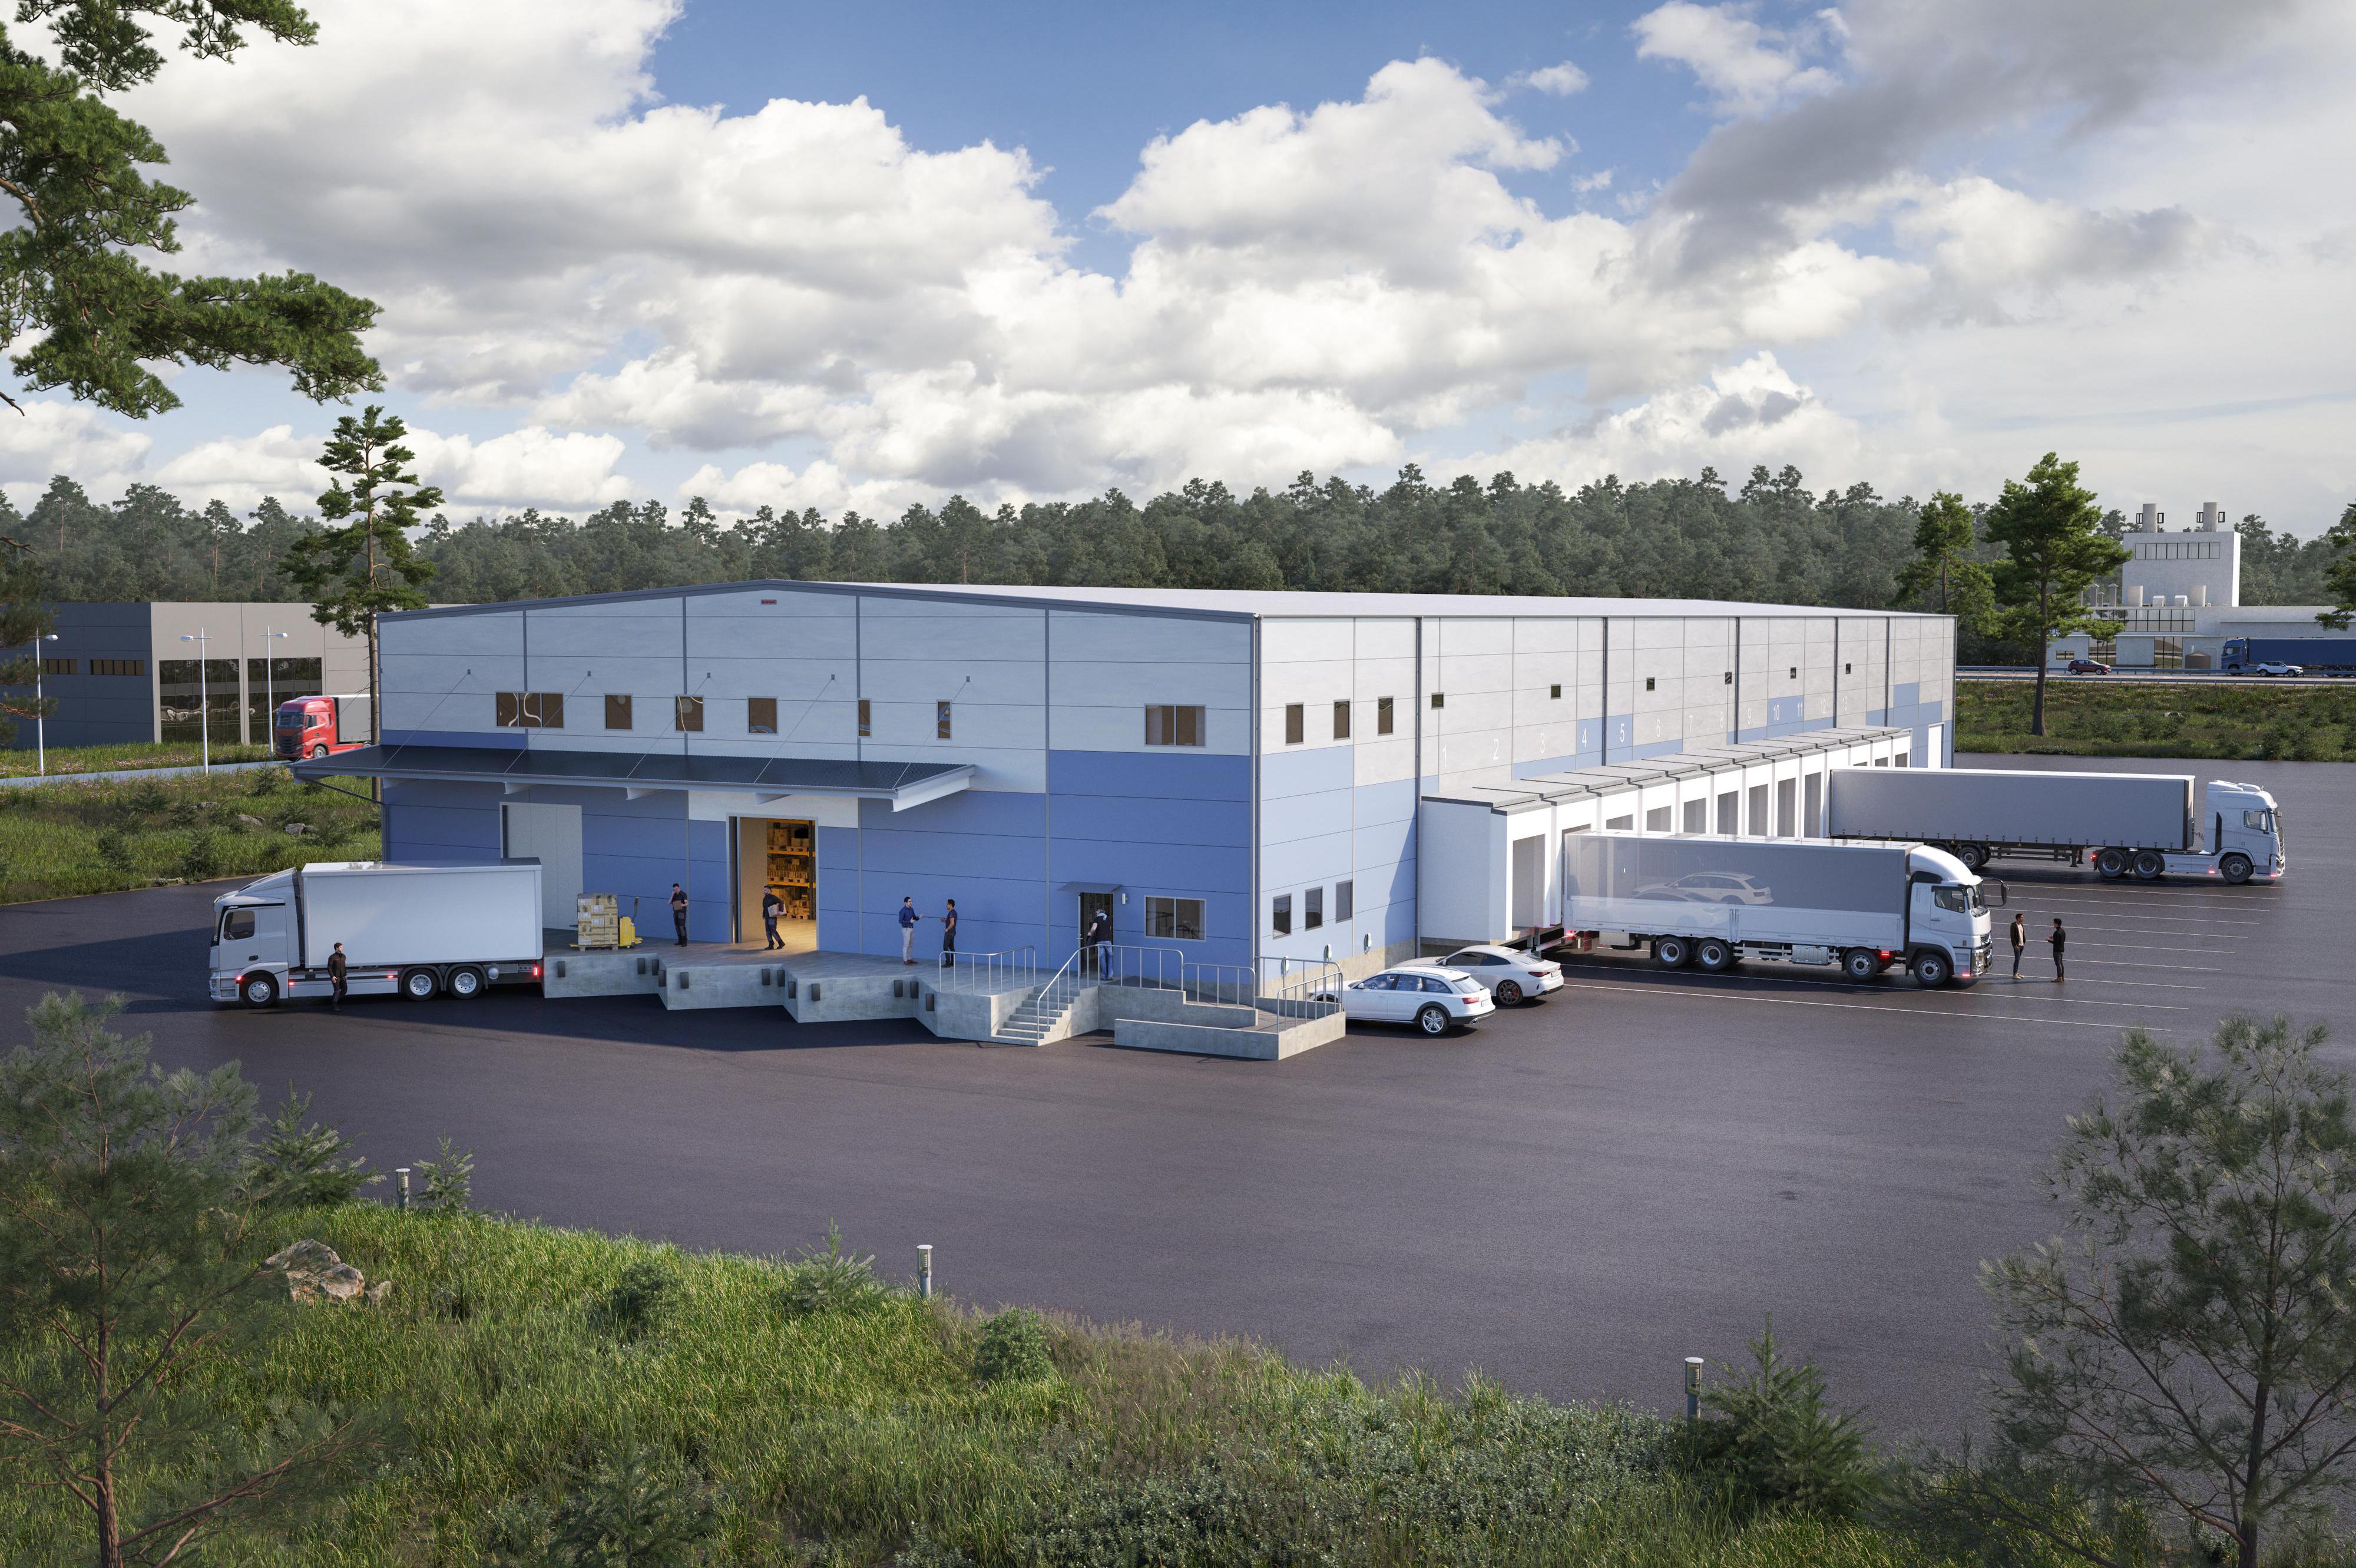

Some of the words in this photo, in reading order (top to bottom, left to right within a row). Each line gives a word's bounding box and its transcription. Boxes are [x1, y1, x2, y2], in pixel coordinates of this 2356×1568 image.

[1773, 704, 1780, 720] 10
[1797, 702, 1803, 717] 11
[1821, 699, 1826, 714] 12
[1842, 696, 1848, 711] 13
[1689, 715, 1693, 732] 7
[1720, 712, 1724, 729] 8
[1748, 708, 1752, 725] 9
[1620, 723, 1625, 742] 5
[1656, 719, 1661, 737] 6
[1540, 733, 1545, 754] 3
[1581, 727, 1587, 747] 4
[1442, 744, 1447, 768] 1
[1493, 739, 1499, 760] 2
